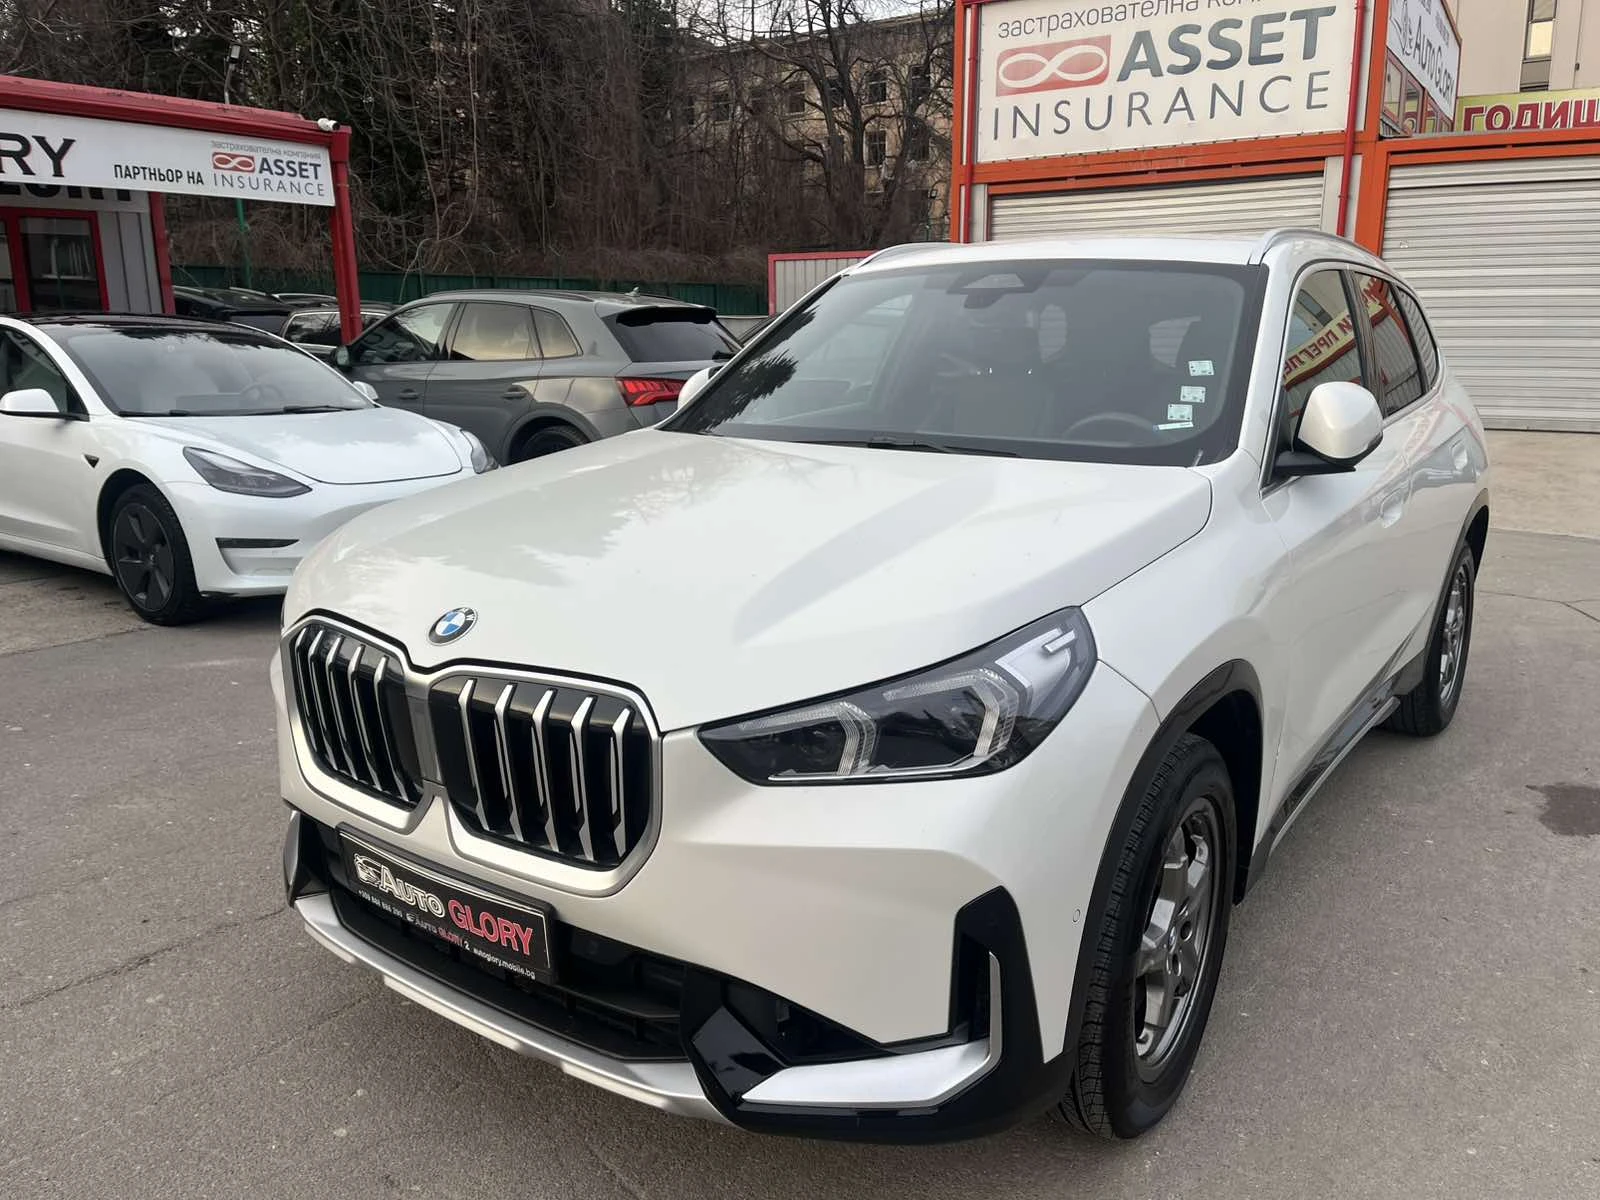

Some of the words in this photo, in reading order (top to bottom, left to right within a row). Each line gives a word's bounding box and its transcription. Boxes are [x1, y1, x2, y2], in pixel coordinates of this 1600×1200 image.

[998, 0, 1199, 37] застрахователна
[1117, 5, 1336, 83] ASSET
[994, 71, 1331, 141] INSURANCE
[114, 164, 183, 183] ПАРТНЬОР
[187, 171, 204, 185] НА
[213, 173, 325, 197] INSURANCE
[259, 157, 321, 180] ASSET
[379, 865, 445, 918] AUTO
[448, 899, 533, 956] GLORY
